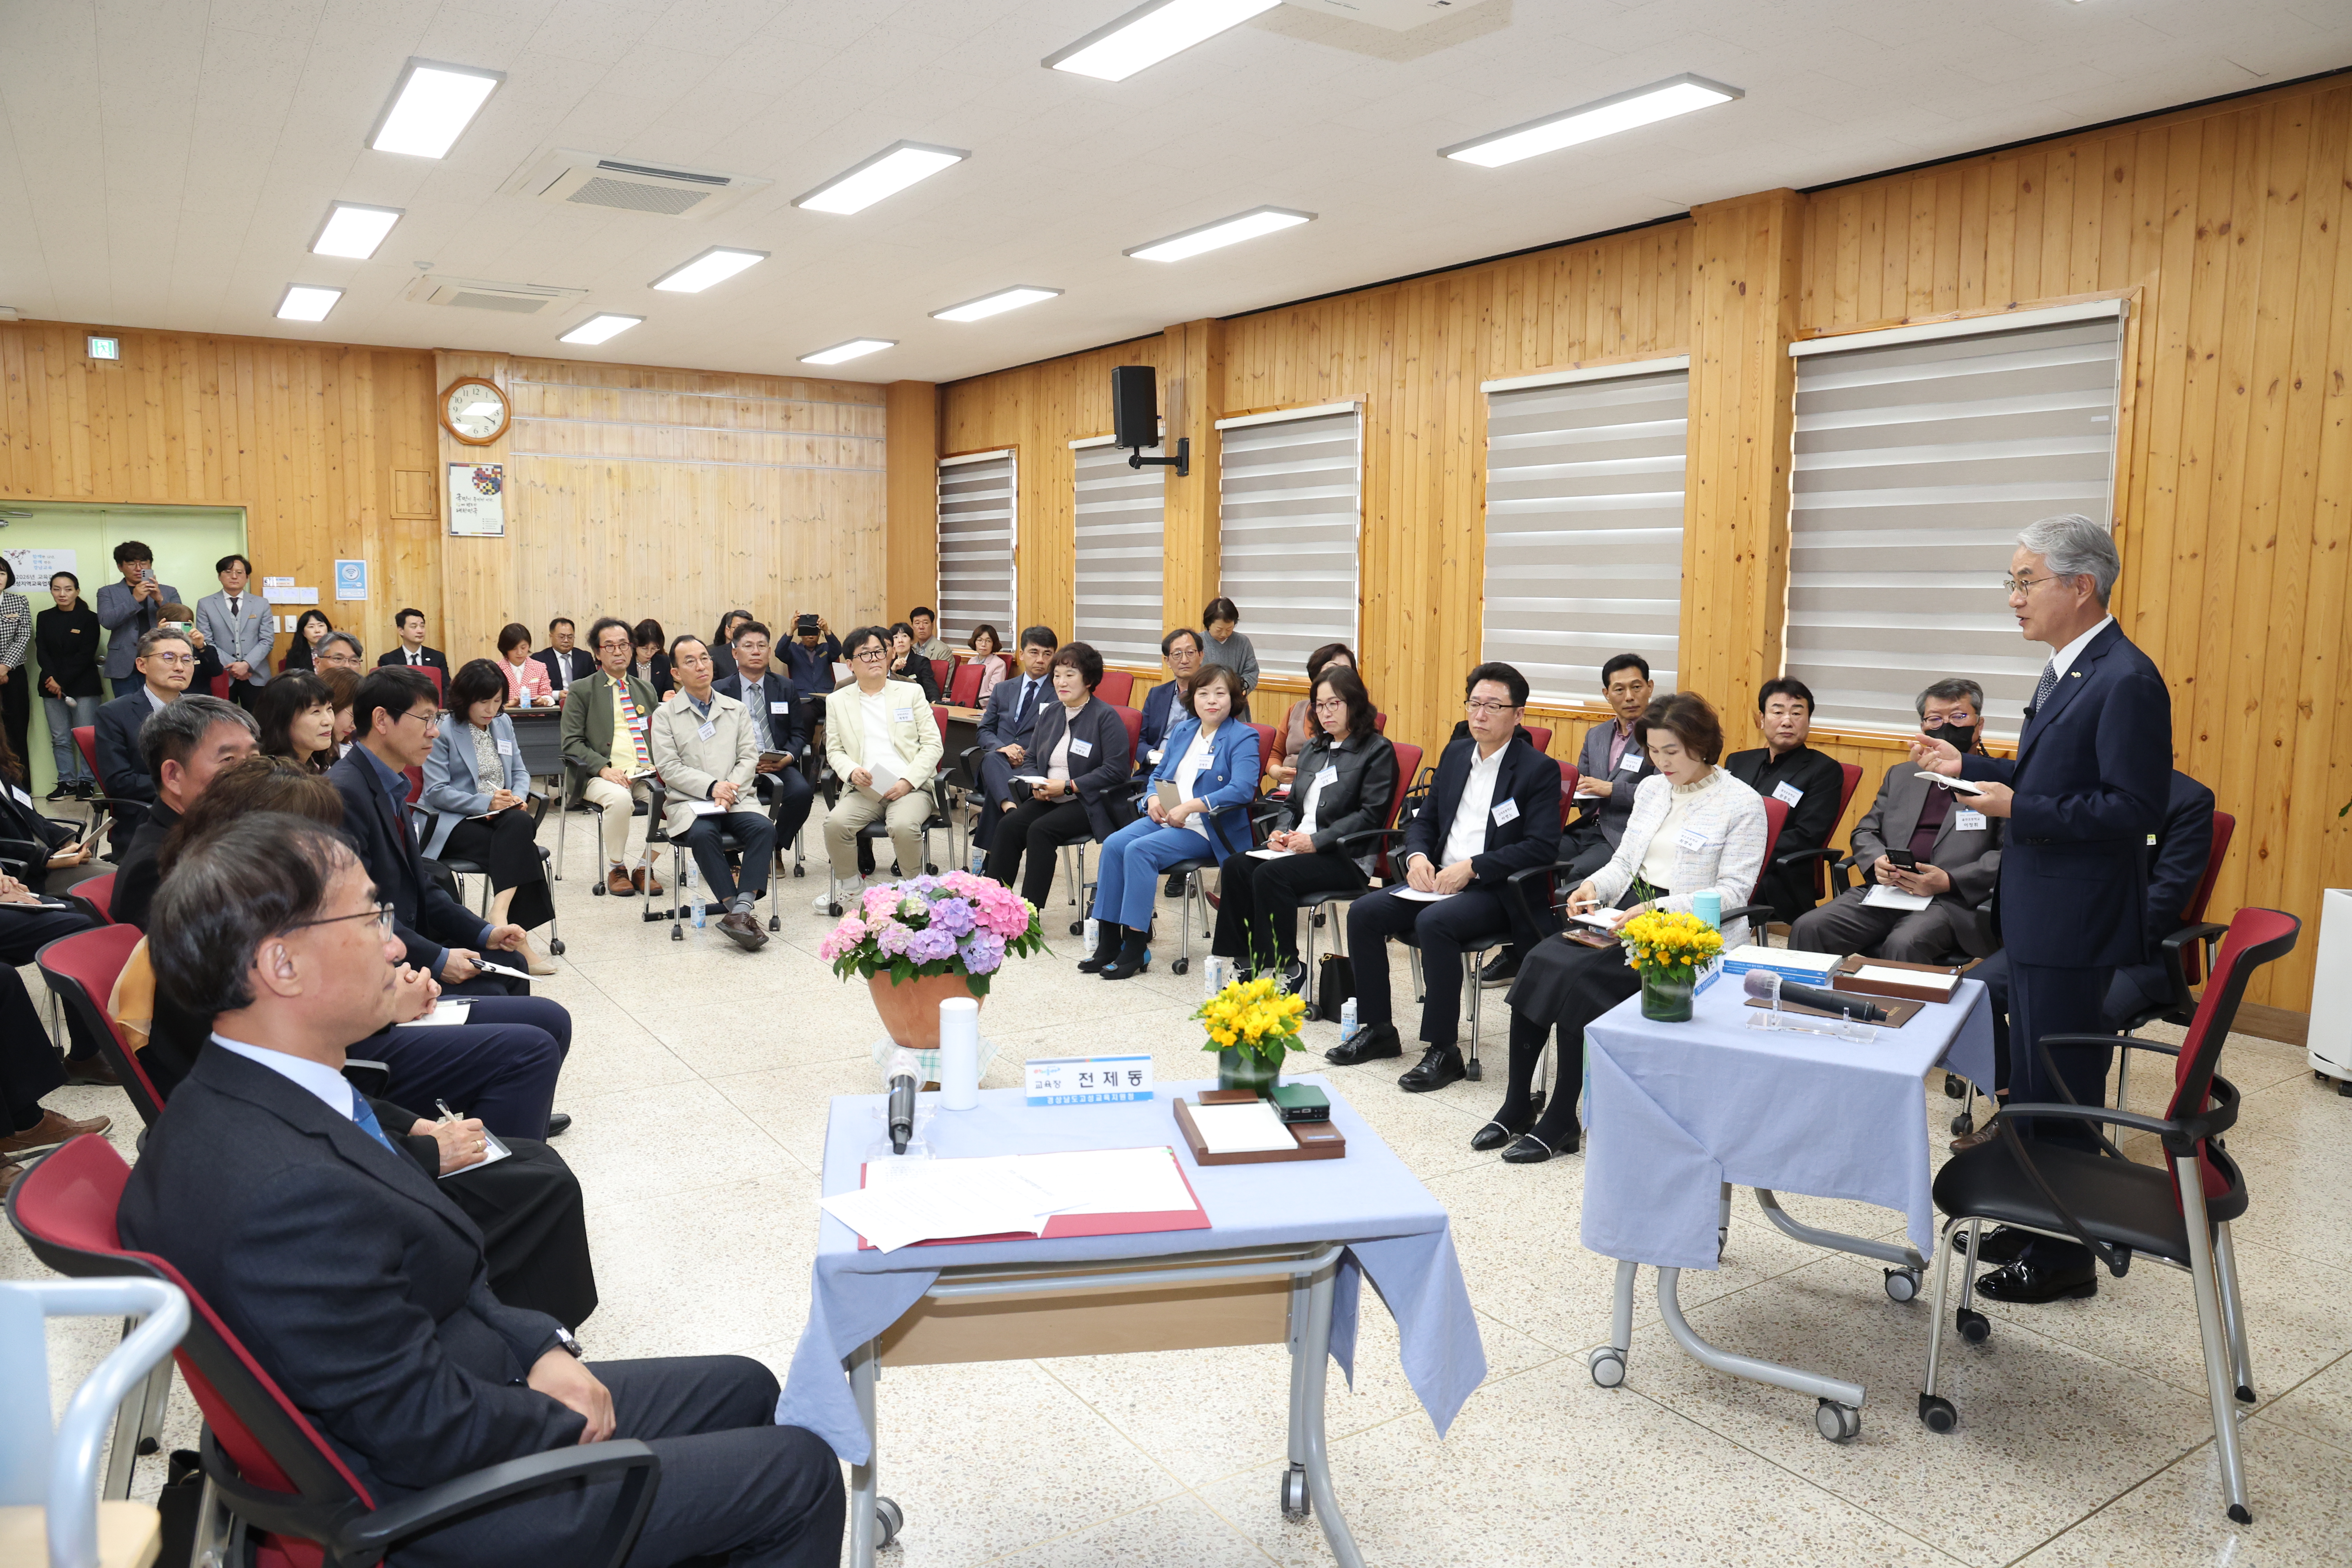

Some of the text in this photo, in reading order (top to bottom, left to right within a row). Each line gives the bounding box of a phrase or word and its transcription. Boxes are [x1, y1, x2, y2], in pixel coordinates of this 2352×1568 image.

[456, 508, 478, 517] 대한민국
[1035, 1080, 1062, 1089] 교육장
[1047, 1093, 1134, 1105] 경상남도고성교육지원청
